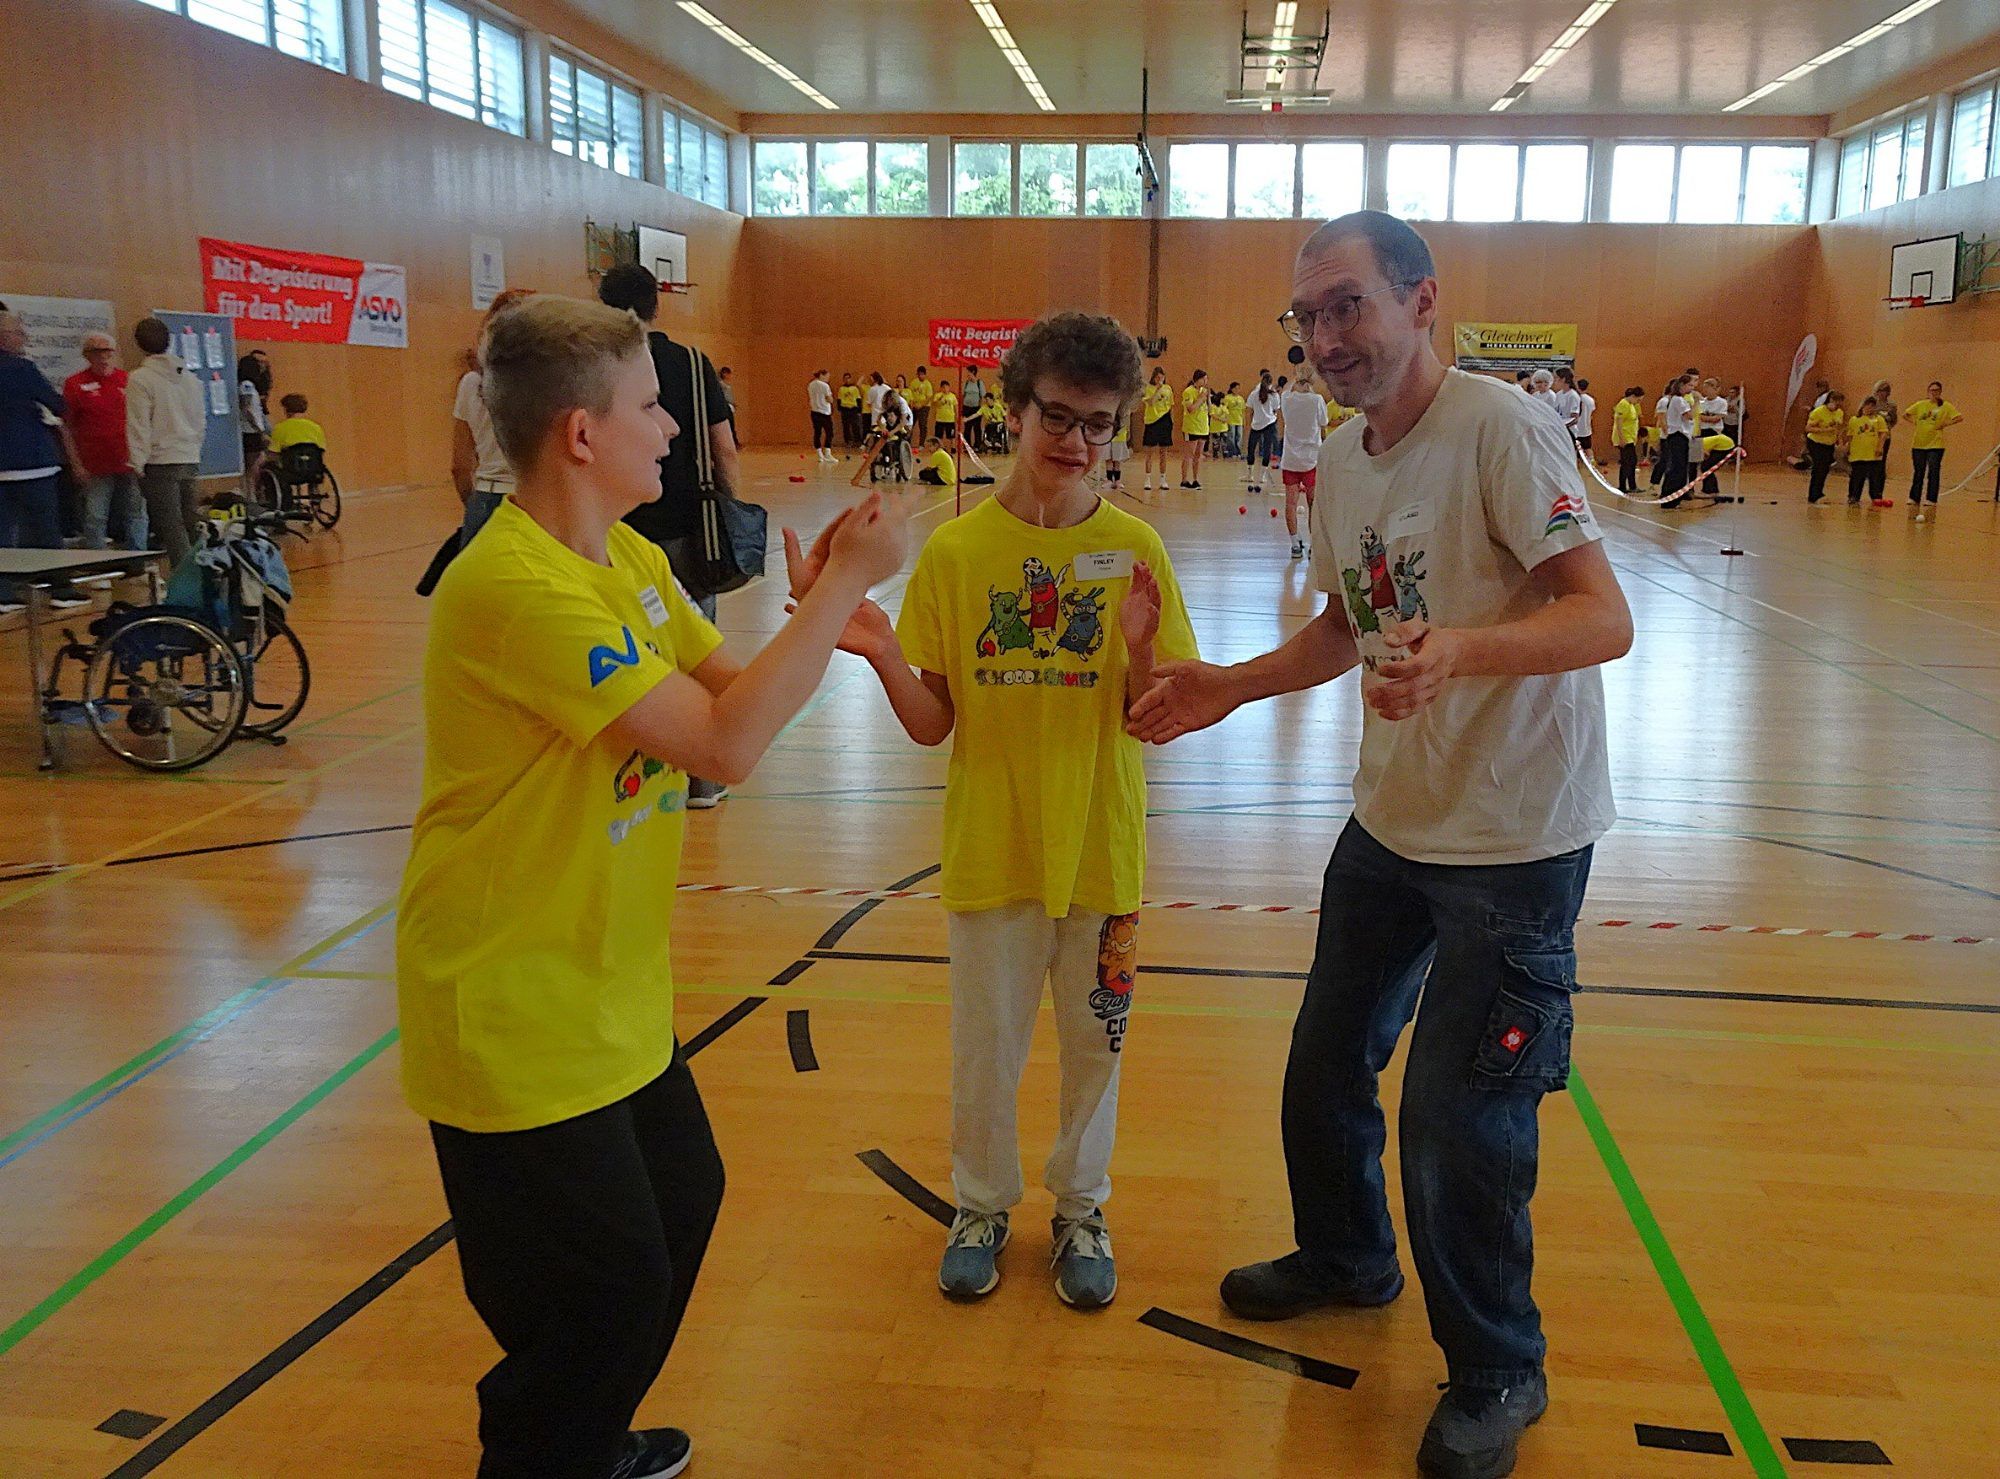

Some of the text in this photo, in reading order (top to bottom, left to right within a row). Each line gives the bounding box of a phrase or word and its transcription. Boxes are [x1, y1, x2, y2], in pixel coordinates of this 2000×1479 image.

[212, 256, 353, 300] Mit Begeisterung
[249, 294, 281, 320] den
[284, 298, 333, 329] Sport!
[935, 326, 962, 340] Mit
[937, 344, 960, 360] für
[962, 345, 989, 358] den
